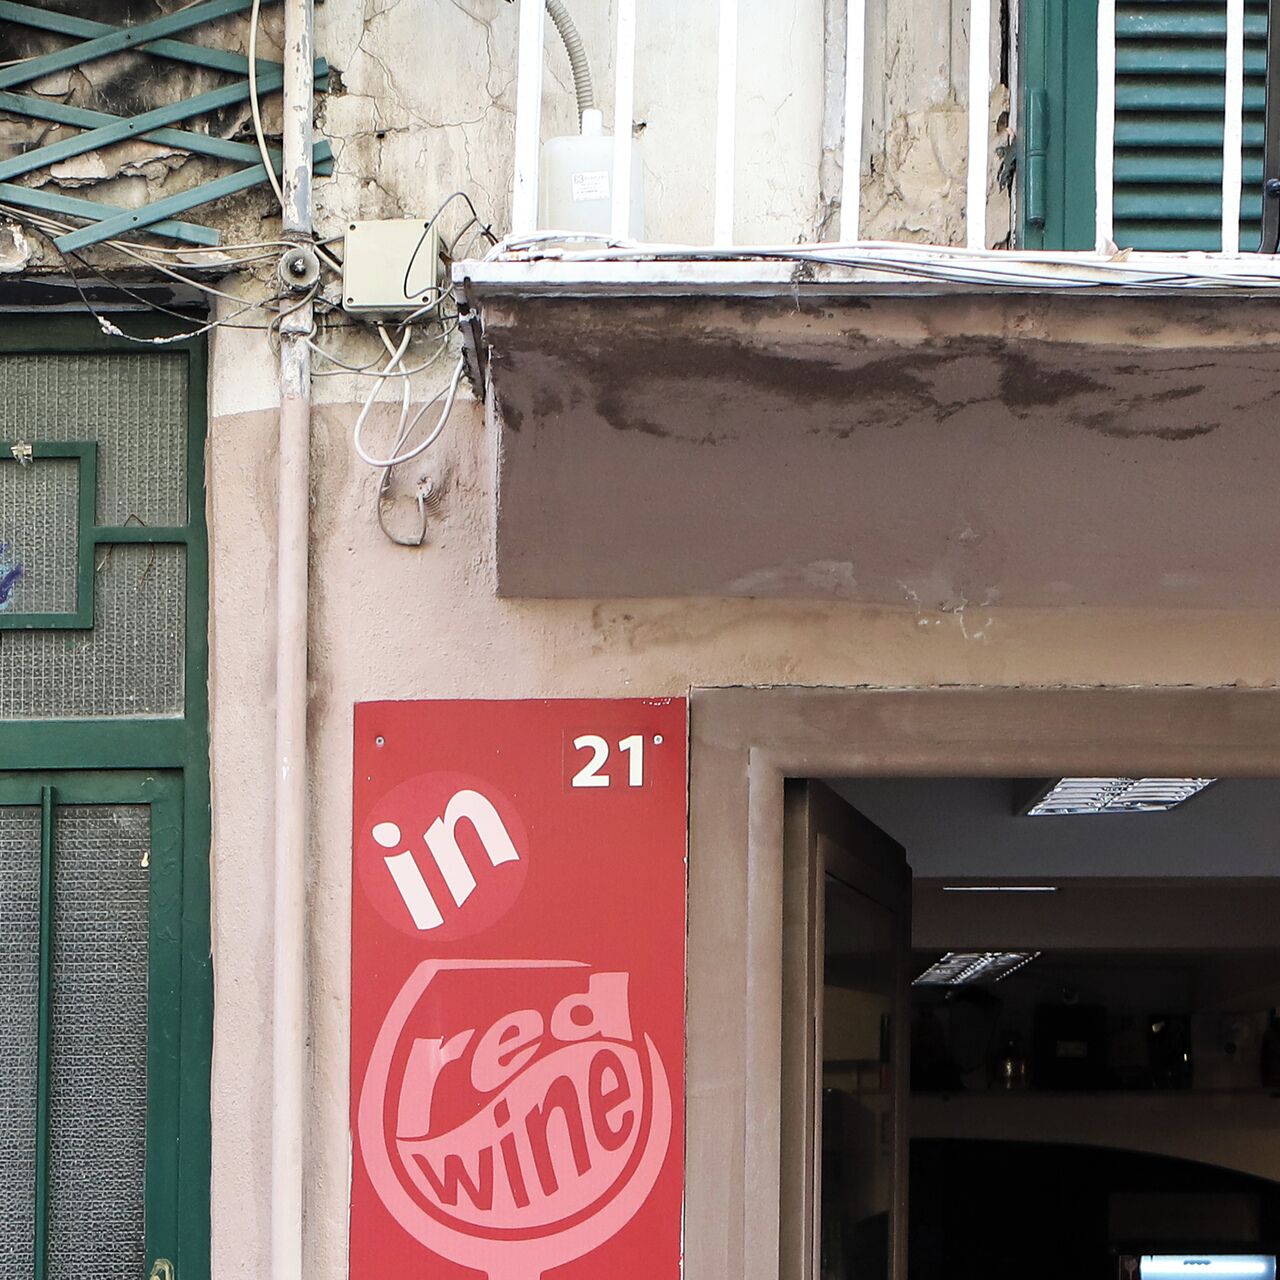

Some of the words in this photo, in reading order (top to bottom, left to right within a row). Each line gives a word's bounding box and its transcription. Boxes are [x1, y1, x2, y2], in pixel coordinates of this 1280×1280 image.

[570, 735, 646, 788] 21
[372, 789, 520, 930] in
[396, 972, 633, 1139] red
[413, 1048, 635, 1211] wine
